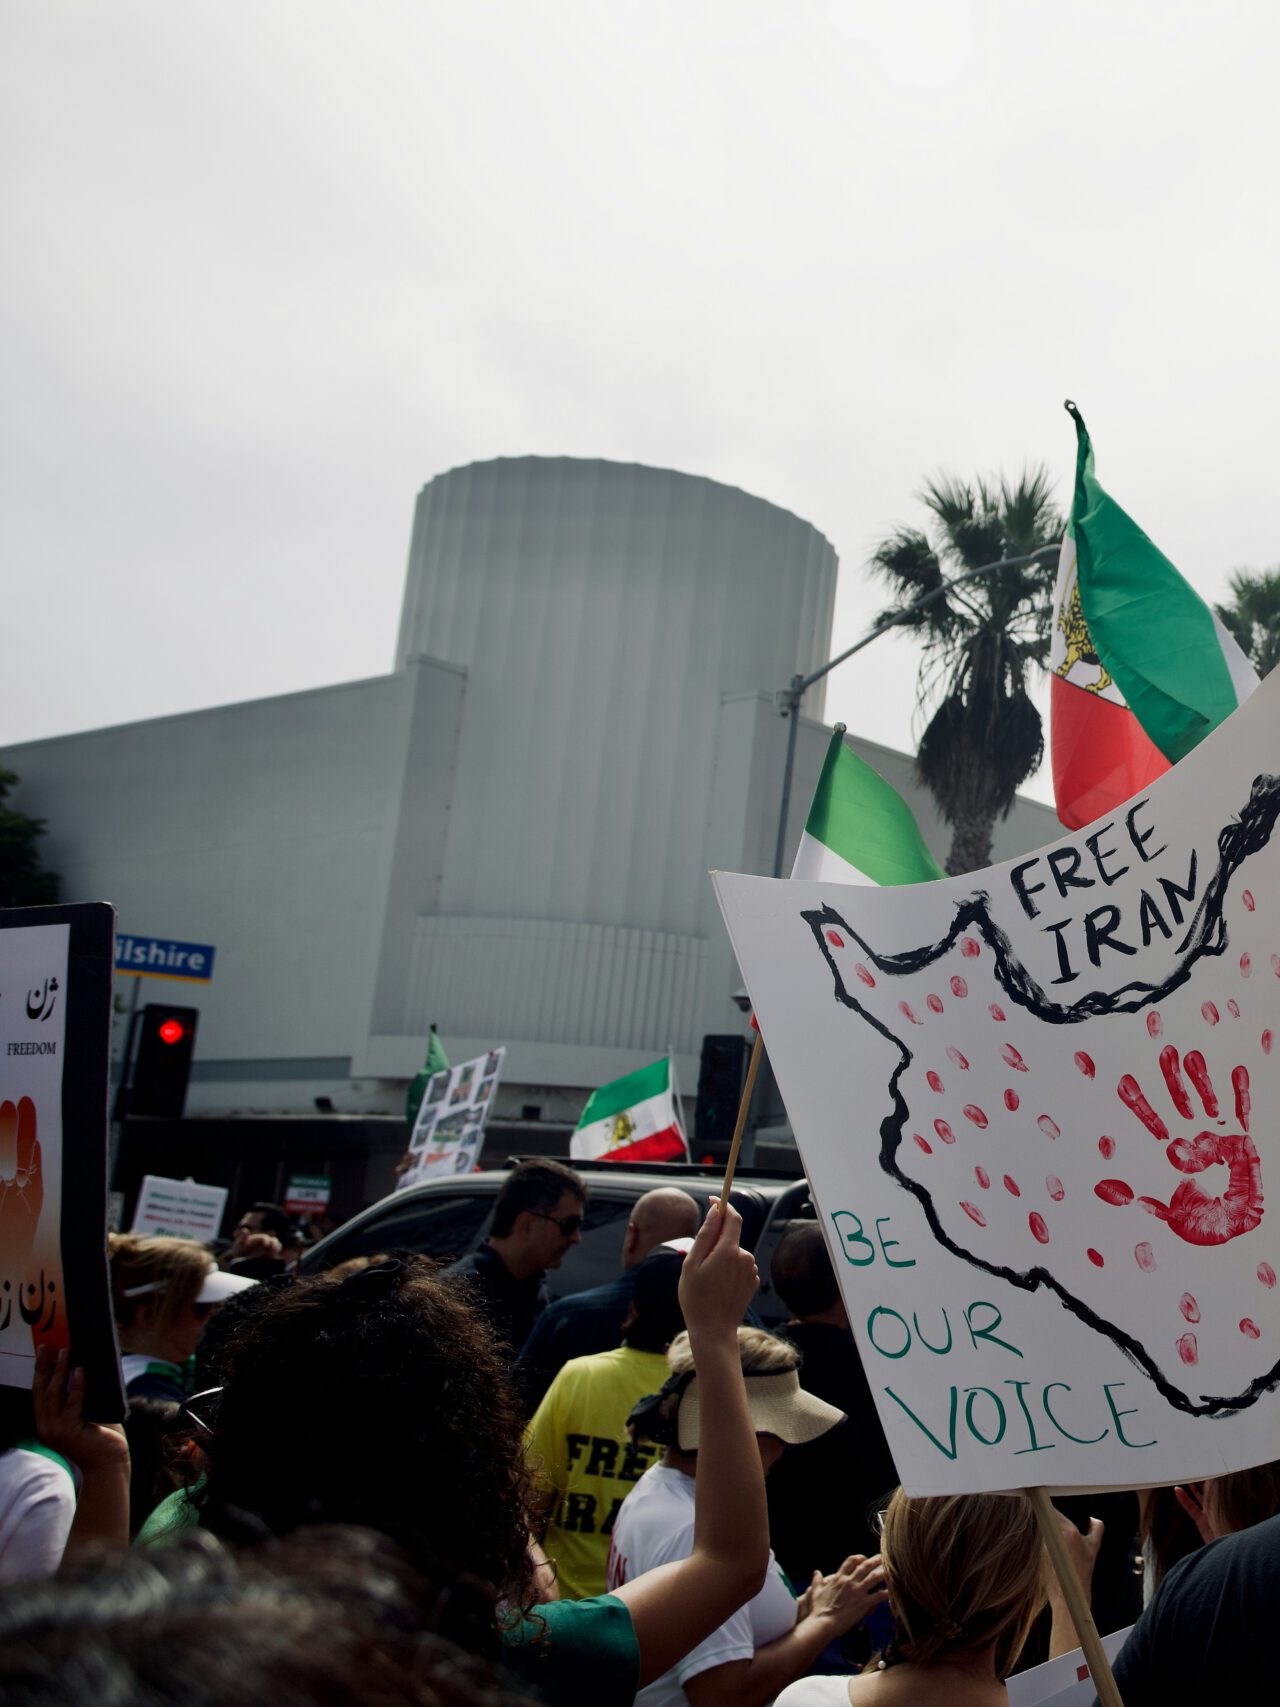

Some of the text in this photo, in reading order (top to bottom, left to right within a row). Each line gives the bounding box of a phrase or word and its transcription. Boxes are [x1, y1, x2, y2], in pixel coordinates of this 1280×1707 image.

[1010, 797, 1168, 921] FREE
[1040, 848, 1199, 984] IRAN
[115, 938, 205, 971] ilshire
[7, 1041, 57, 1056] FREEDOM
[830, 1210, 916, 1268] BE
[867, 1300, 1024, 1360] OUR
[884, 1379, 1158, 1460] VOICE
[566, 1433, 666, 1482] FRE
